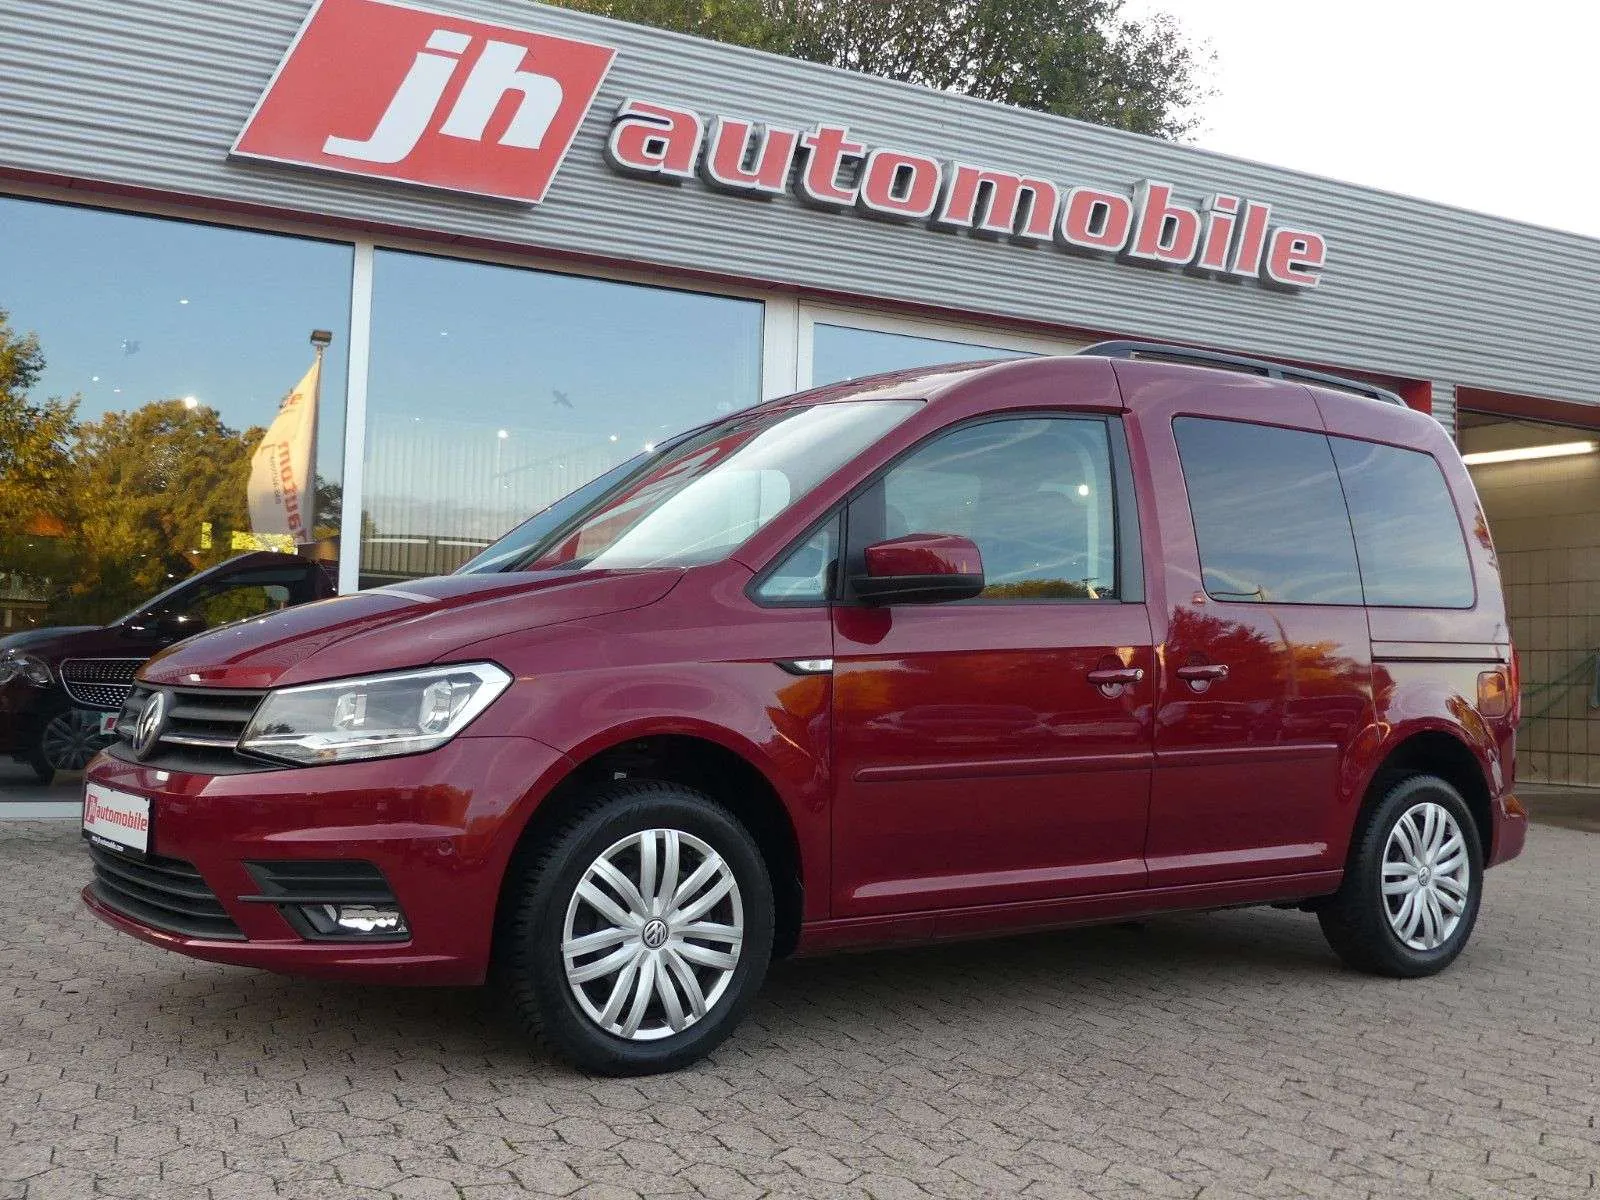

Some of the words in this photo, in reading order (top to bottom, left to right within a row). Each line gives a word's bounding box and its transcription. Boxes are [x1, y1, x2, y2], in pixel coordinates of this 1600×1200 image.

[322, 28, 564, 164] jh
[606, 98, 1328, 289] automobile
[97, 805, 148, 831] automobile
